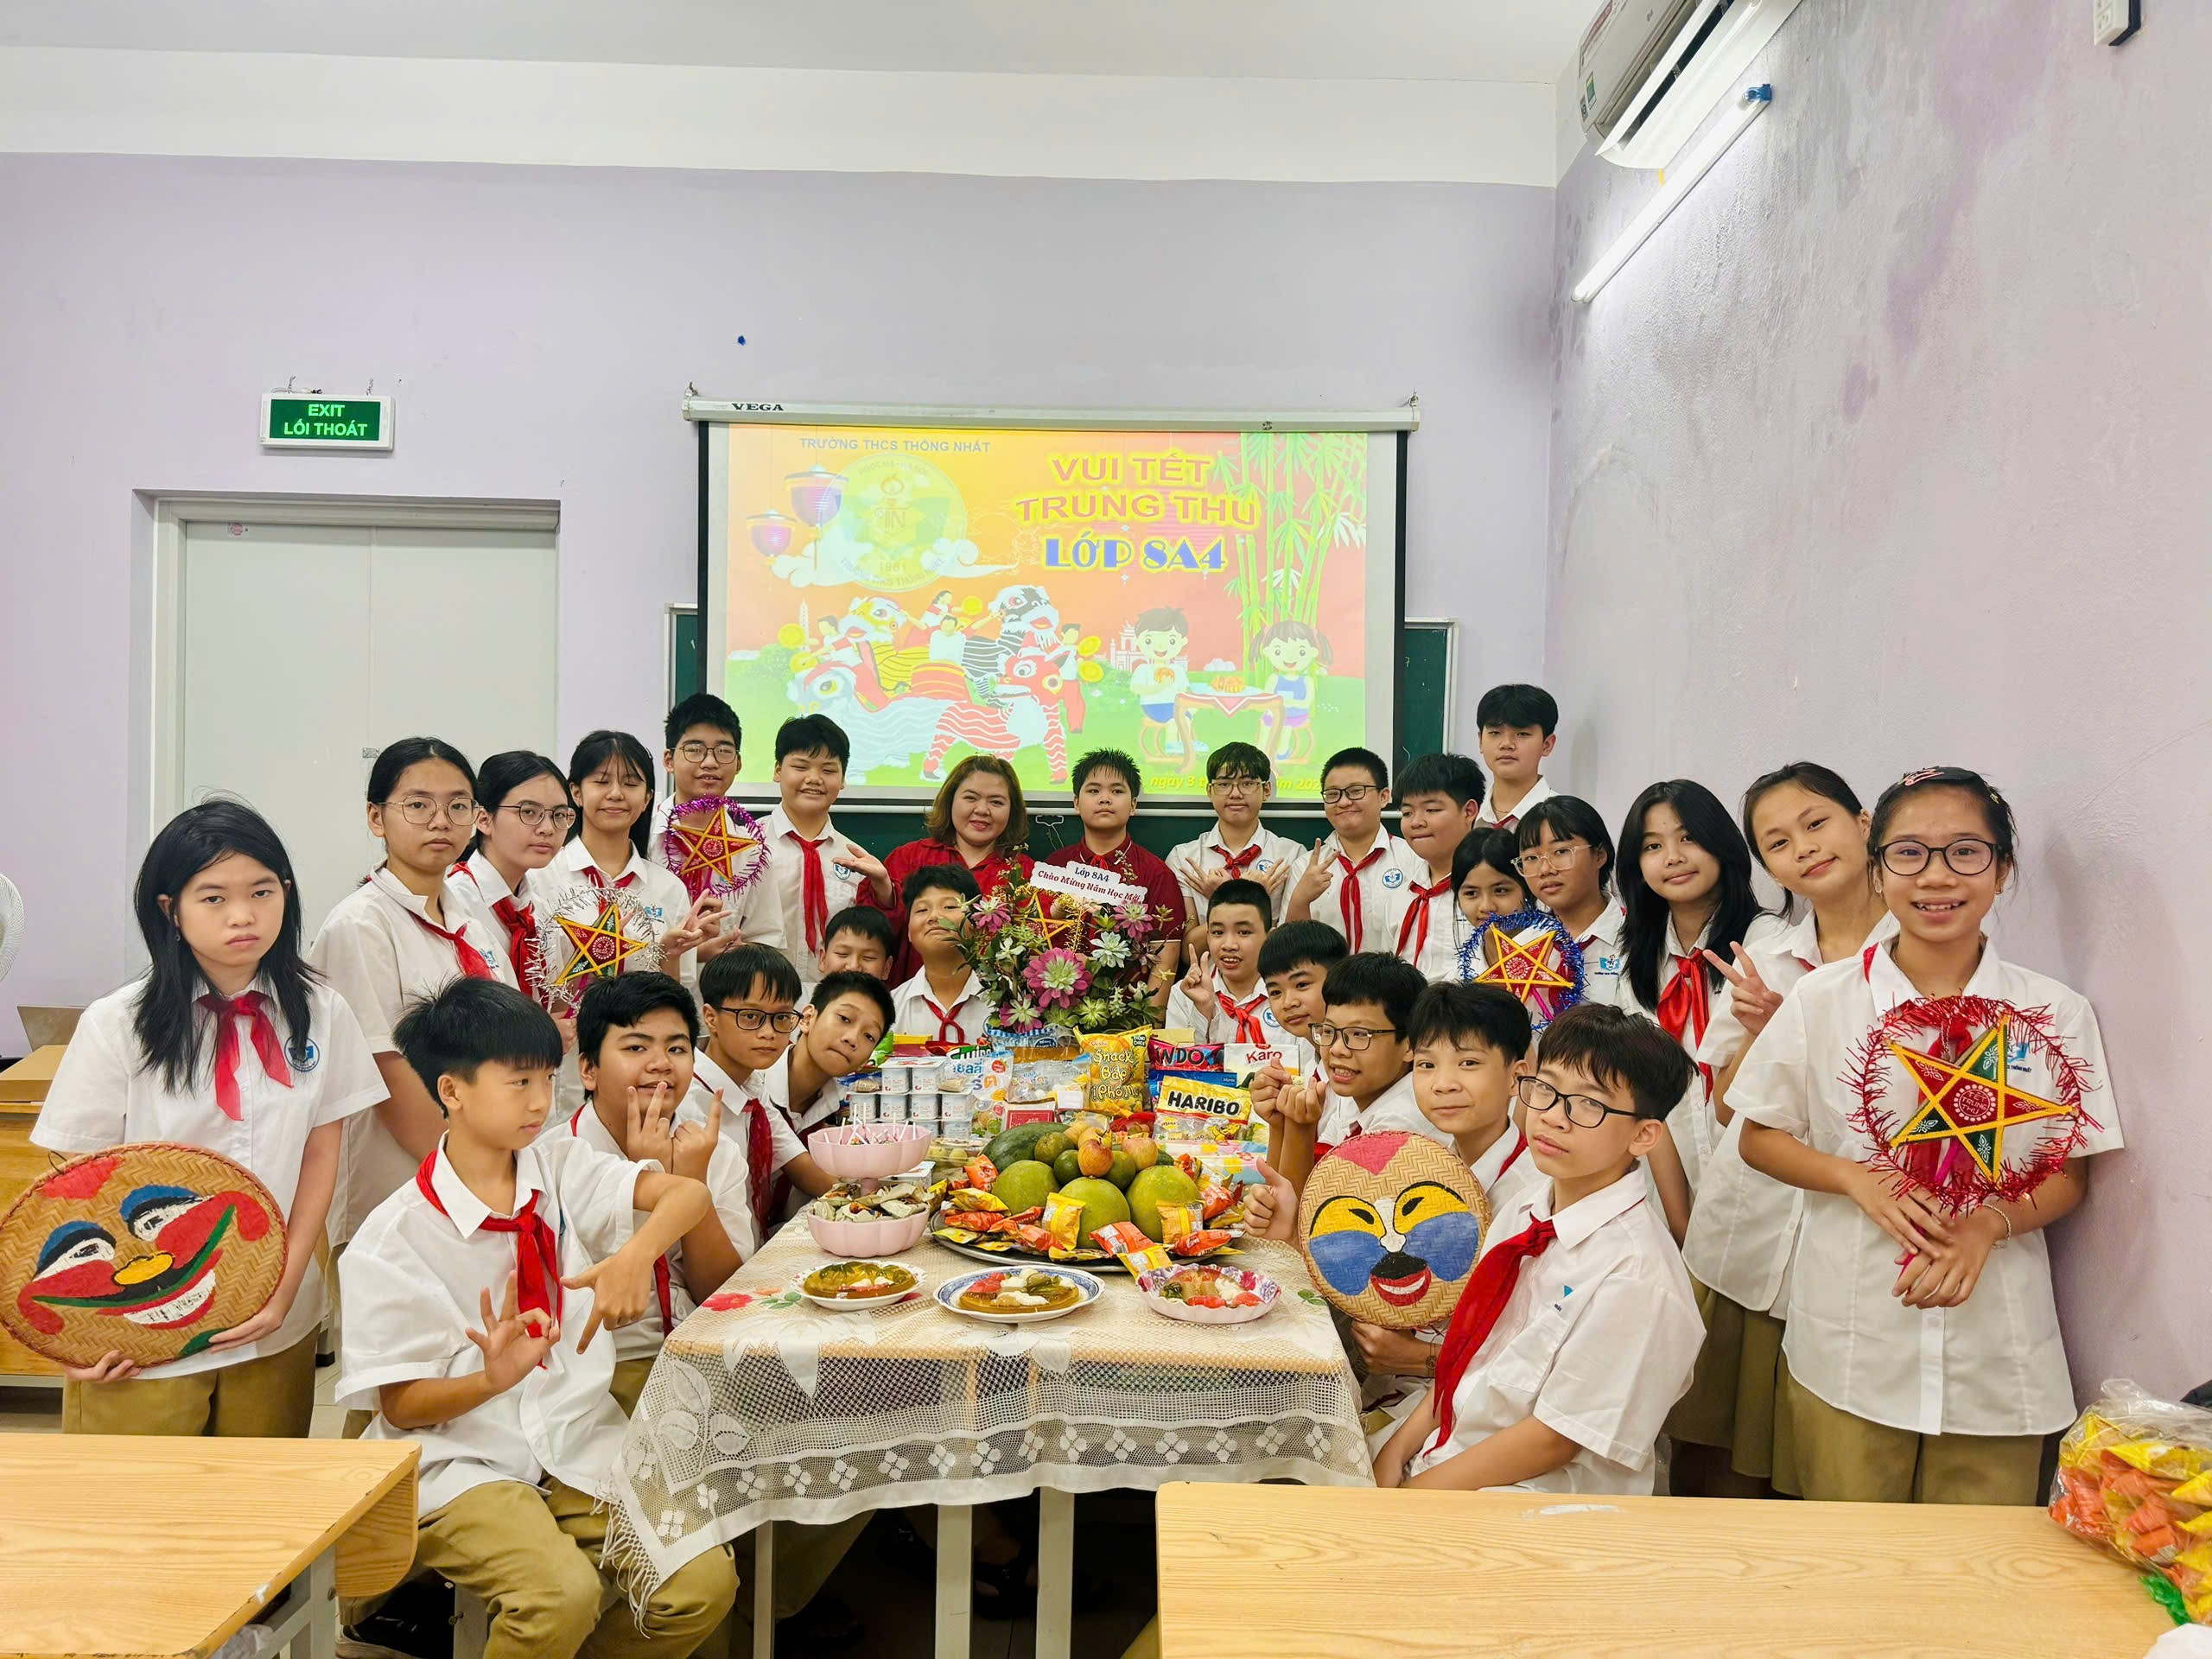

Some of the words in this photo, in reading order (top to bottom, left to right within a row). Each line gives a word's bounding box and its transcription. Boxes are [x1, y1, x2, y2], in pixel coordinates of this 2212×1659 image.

[308, 404, 345, 417] EXIT
[732, 403, 784, 411] VEGA
[283, 418, 309, 435] LỐI
[314, 420, 368, 436] THOÁT
[800, 436, 859, 449] TRƯỜNG
[864, 439, 899, 450] THCS
[1052, 456, 1120, 481] VUI
[1132, 452, 1211, 483] TẾT
[1015, 493, 1161, 522] TRUNG
[1173, 495, 1255, 526] THU
[1045, 531, 1133, 569] LỚP
[1143, 537, 1225, 569] 8A4
[1075, 867, 1090, 879] Lớp
[1091, 871, 1110, 882] 8A4
[1038, 870, 1059, 882] Chào
[1086, 882, 1106, 894] Năm
[1107, 887, 1123, 899] Học
[1092, 1047, 1134, 1065] Snack
[1246, 1050, 1283, 1064] Karo
[1166, 1090, 1241, 1116] HARIBO
[1961, 1096, 1987, 1111] TRUNG
